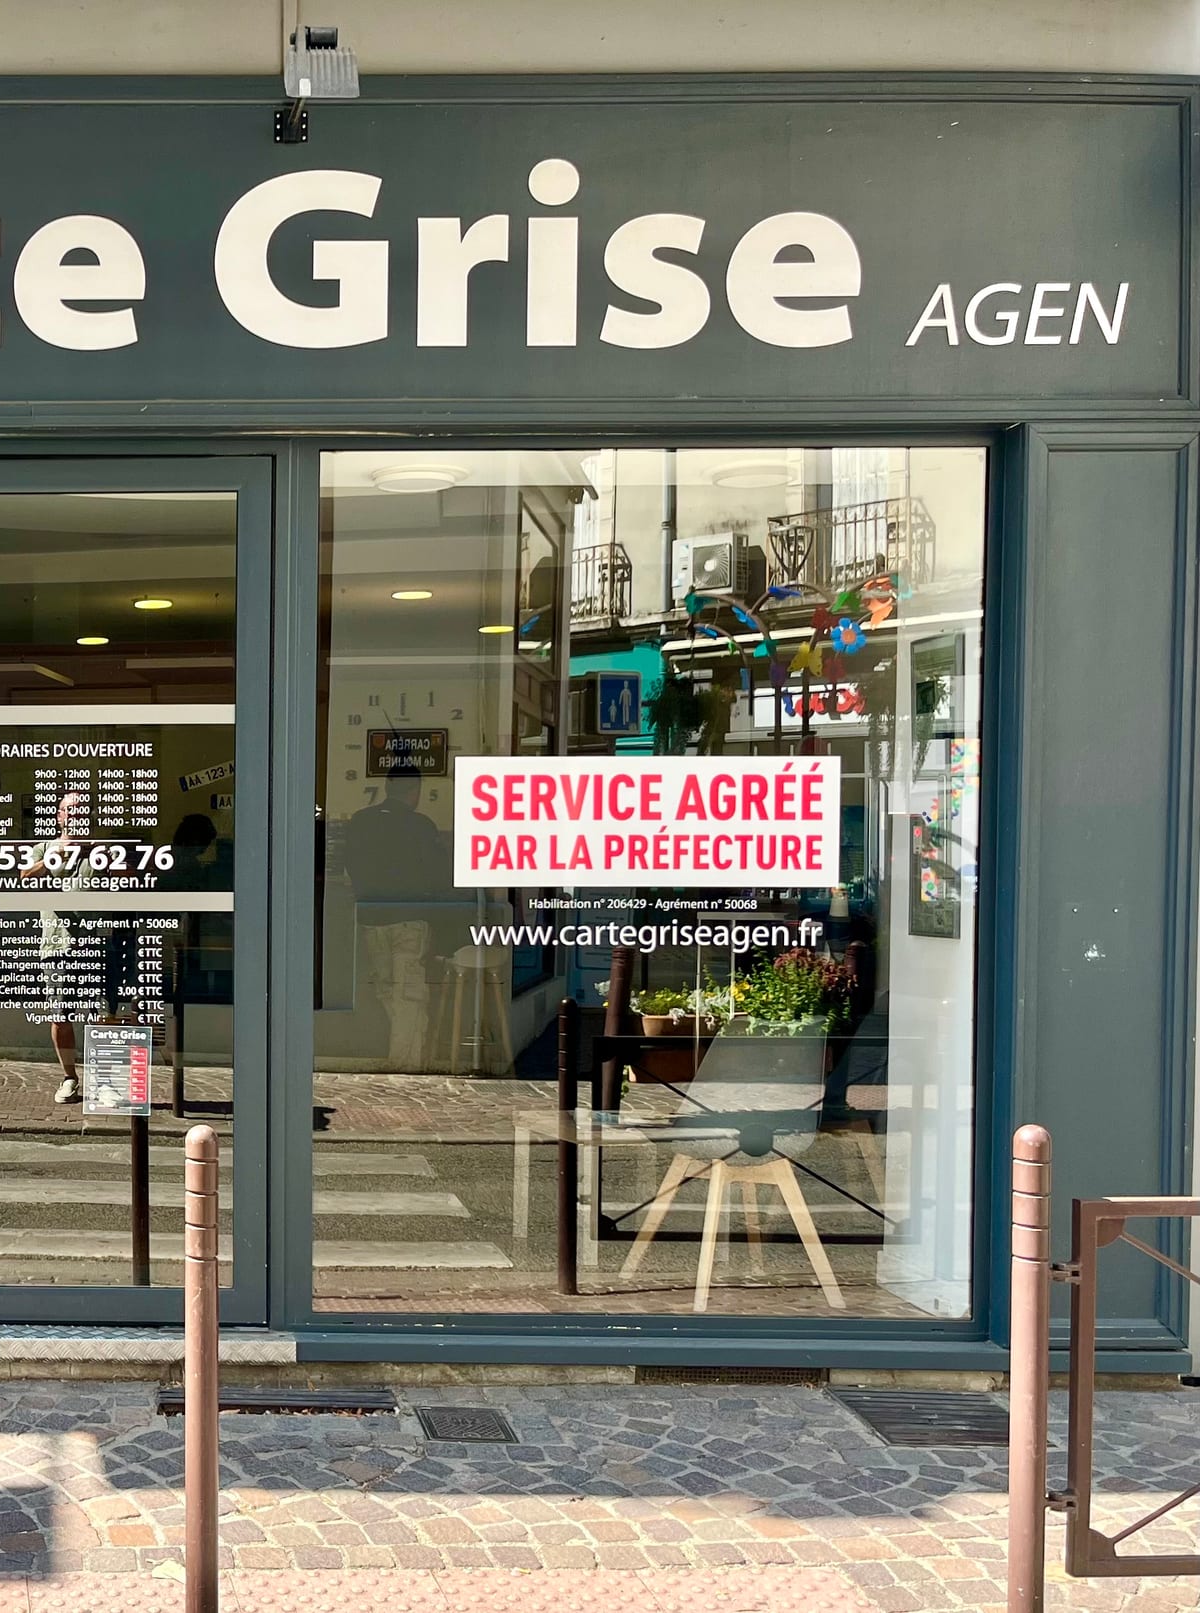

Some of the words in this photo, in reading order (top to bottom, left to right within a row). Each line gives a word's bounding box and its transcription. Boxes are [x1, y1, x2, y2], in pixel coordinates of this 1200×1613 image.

[214, 158, 863, 350] Grise
[905, 282, 1130, 347] AGEN
[54, 743, 153, 757] D'OUVERTURE
[34, 769, 57, 779] 9h00
[64, 769, 91, 779] 12h00
[98, 769, 124, 779] 14h00
[131, 769, 158, 779] 18h00
[34, 781, 57, 791] 9h00
[64, 781, 91, 791] 12h00
[98, 781, 124, 791] 14h00
[131, 781, 158, 791] 18h00
[471, 773, 662, 821] SERVICE
[674, 762, 823, 821] AGRÉÉ
[34, 793, 57, 803] 9h00
[98, 793, 124, 803] 14h00
[131, 793, 158, 803] 18h00
[34, 805, 57, 815] 9h00
[98, 805, 124, 815] 14h00
[131, 805, 158, 815] 18h00
[34, 817, 57, 827] 9h00
[64, 817, 91, 827] 12h00
[98, 817, 124, 827] 14h00
[131, 817, 158, 827] 17h00
[34, 827, 56, 836] 9h00
[63, 827, 90, 836] 12h00
[470, 835, 537, 870] PAR
[549, 835, 592, 870] LA
[604, 826, 823, 870] PRÉFECTURE
[43, 845, 81, 871] 67
[88, 845, 127, 871] 62
[135, 845, 174, 871] 76
[529, 898, 591, 910] Habilitation
[607, 899, 647, 910] 206429
[655, 898, 709, 913] Agrément
[724, 899, 758, 910] 50068
[32, 919, 71, 929] 206429
[79, 918, 130, 931] Agrément
[146, 918, 179, 929] 50068
[2, 935, 48, 947] prestation
[51, 936, 75, 945] Carte
[469, 918, 823, 952] www.cartegriseagen.fr
[36, 972, 49, 982] de
[51, 973, 75, 982] Carte
[42, 985, 54, 995] de
[56, 987, 75, 995] non
[26, 1013, 65, 1024] Vignette
[68, 1013, 85, 1023] Crit
[90, 1029, 118, 1040] Carte
[120, 1030, 147, 1041] Grise
